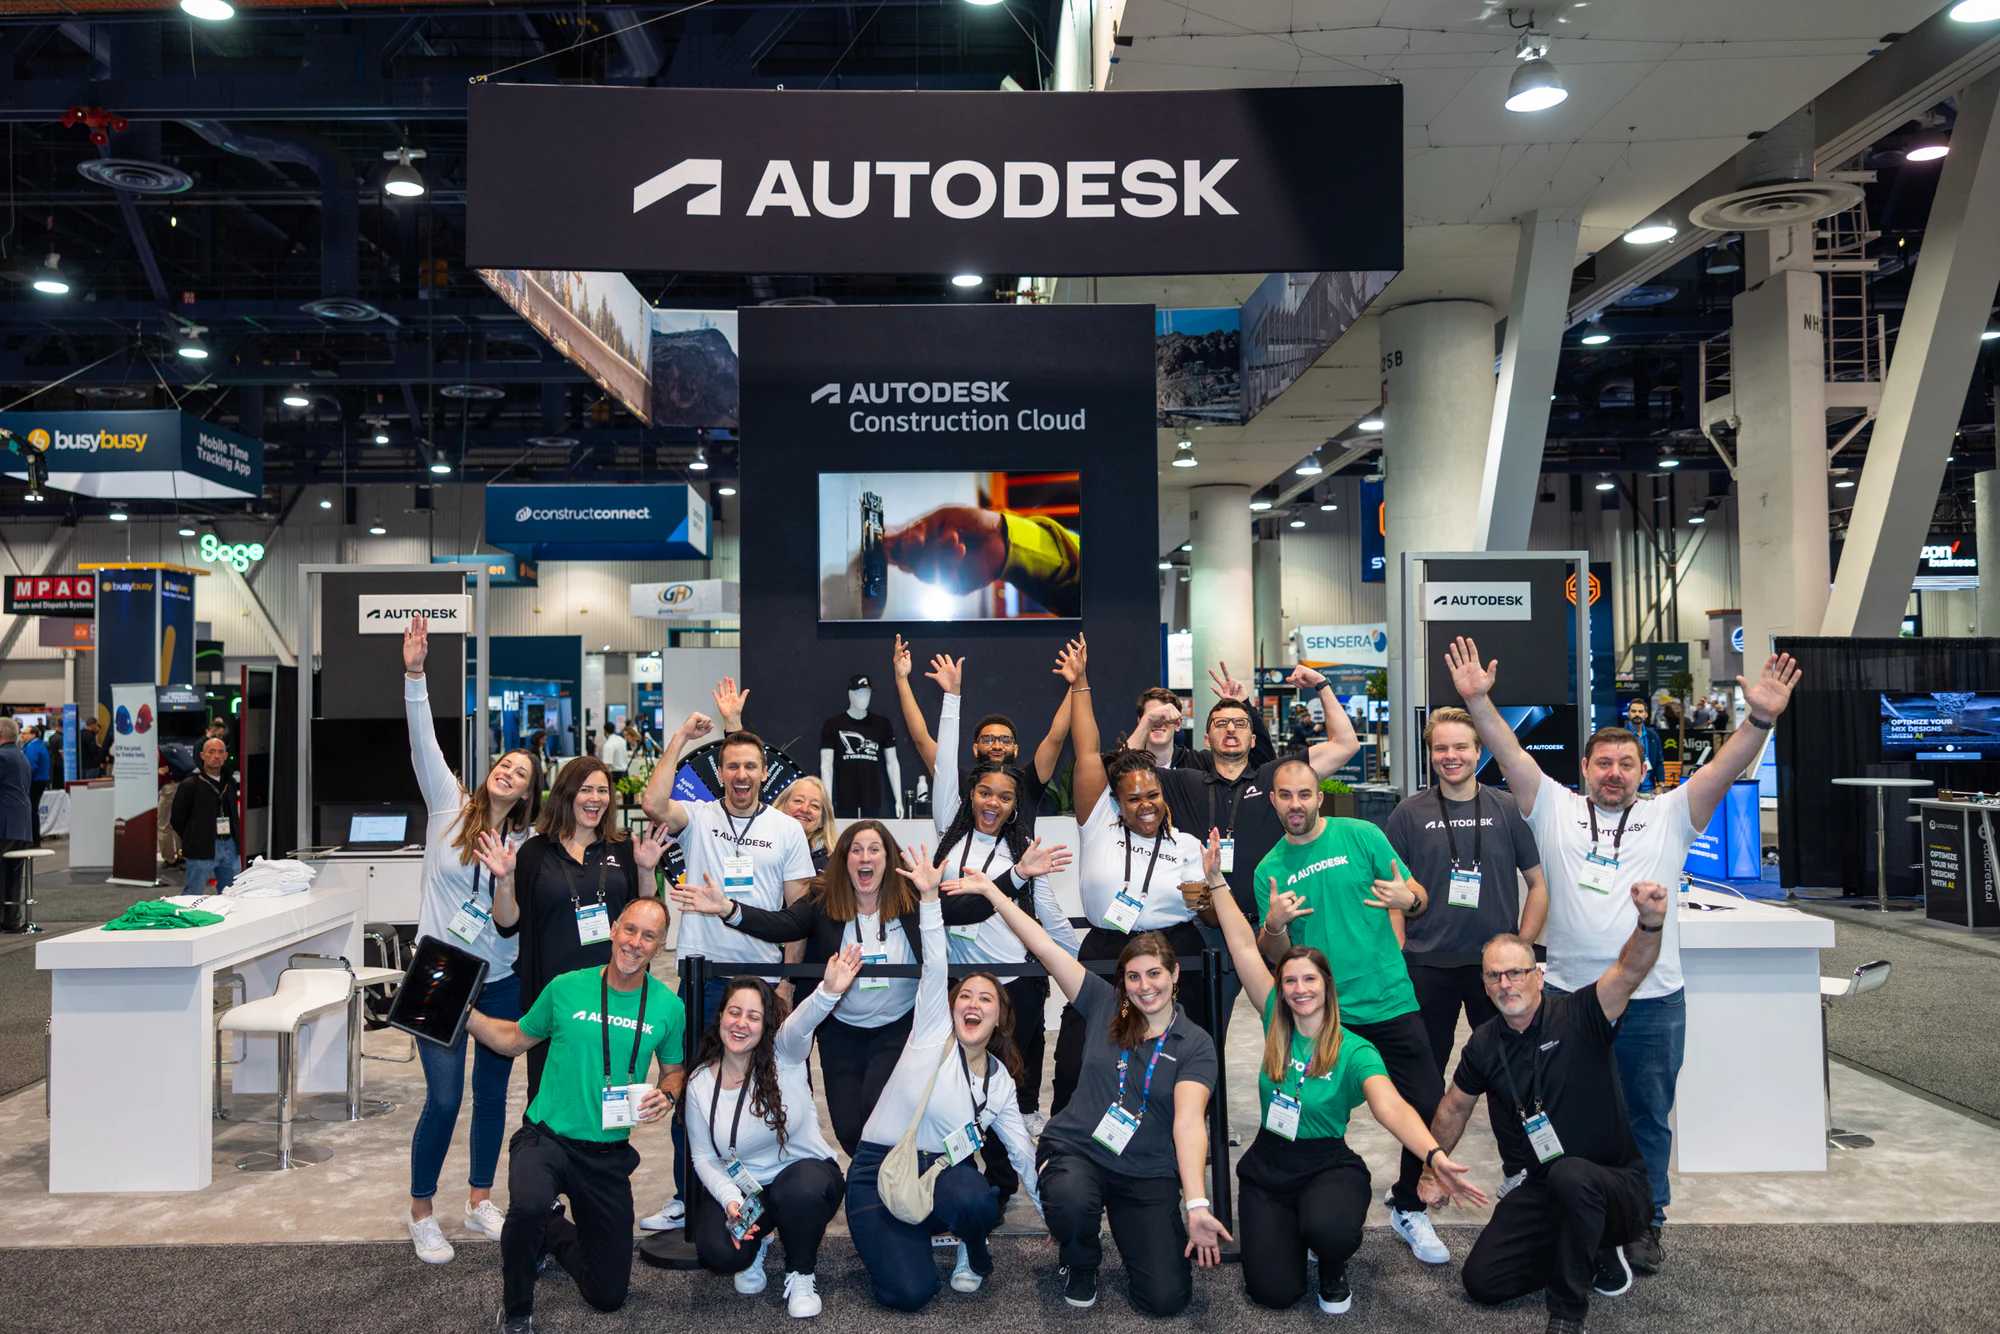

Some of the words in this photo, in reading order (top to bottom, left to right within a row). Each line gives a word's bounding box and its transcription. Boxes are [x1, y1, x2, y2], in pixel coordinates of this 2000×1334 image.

[745, 158, 1240, 219] AUTODESK
[848, 381, 1010, 403] AUTODESK
[850, 408, 1009, 433] Construction
[1017, 408, 1086, 431] Cloud
[54, 430, 148, 452] busybusy
[199, 433, 228, 452] Mobile
[229, 443, 249, 461] Time
[197, 446, 233, 472] Tracking
[234, 459, 251, 477] App
[532, 507, 650, 520] constructconnect
[200, 533, 265, 573] Sage
[1928, 558, 1977, 568] business
[16, 580, 92, 597] MPAQ
[113, 582, 153, 592] busybusy
[13, 601, 30, 610] Batch
[42, 601, 68, 611] Dispatch
[69, 601, 94, 611] Systems
[1451, 596, 1523, 606] AUTODESK
[384, 609, 458, 619] AUTODESK
[1306, 635, 1372, 649] SENSERA
[1665, 655, 1682, 663] Align
[1623, 682, 1640, 690] Align
[1683, 738, 1710, 749] Align
[680, 778, 695, 791] Apple
[762, 765, 784, 793] Constructi
[676, 783, 685, 792] Air
[684, 788, 696, 800] Pods
[1438, 817, 1493, 829] ATODSK
[1590, 822, 1647, 837] UTOESK
[1936, 822, 1958, 830] concrete.ai
[720, 831, 774, 850] AUTODESK
[1125, 846, 1178, 864] UTOESK
[1930, 850, 1958, 861] OPTIMIZE
[1297, 855, 1349, 880] AUTODESK
[1930, 860, 1947, 868] YOUR
[1947, 862, 1959, 871] MIX
[1983, 841, 1995, 903] concrete.ai
[1931, 869, 1956, 880] DESIGNS
[1931, 879, 1947, 888] WITH
